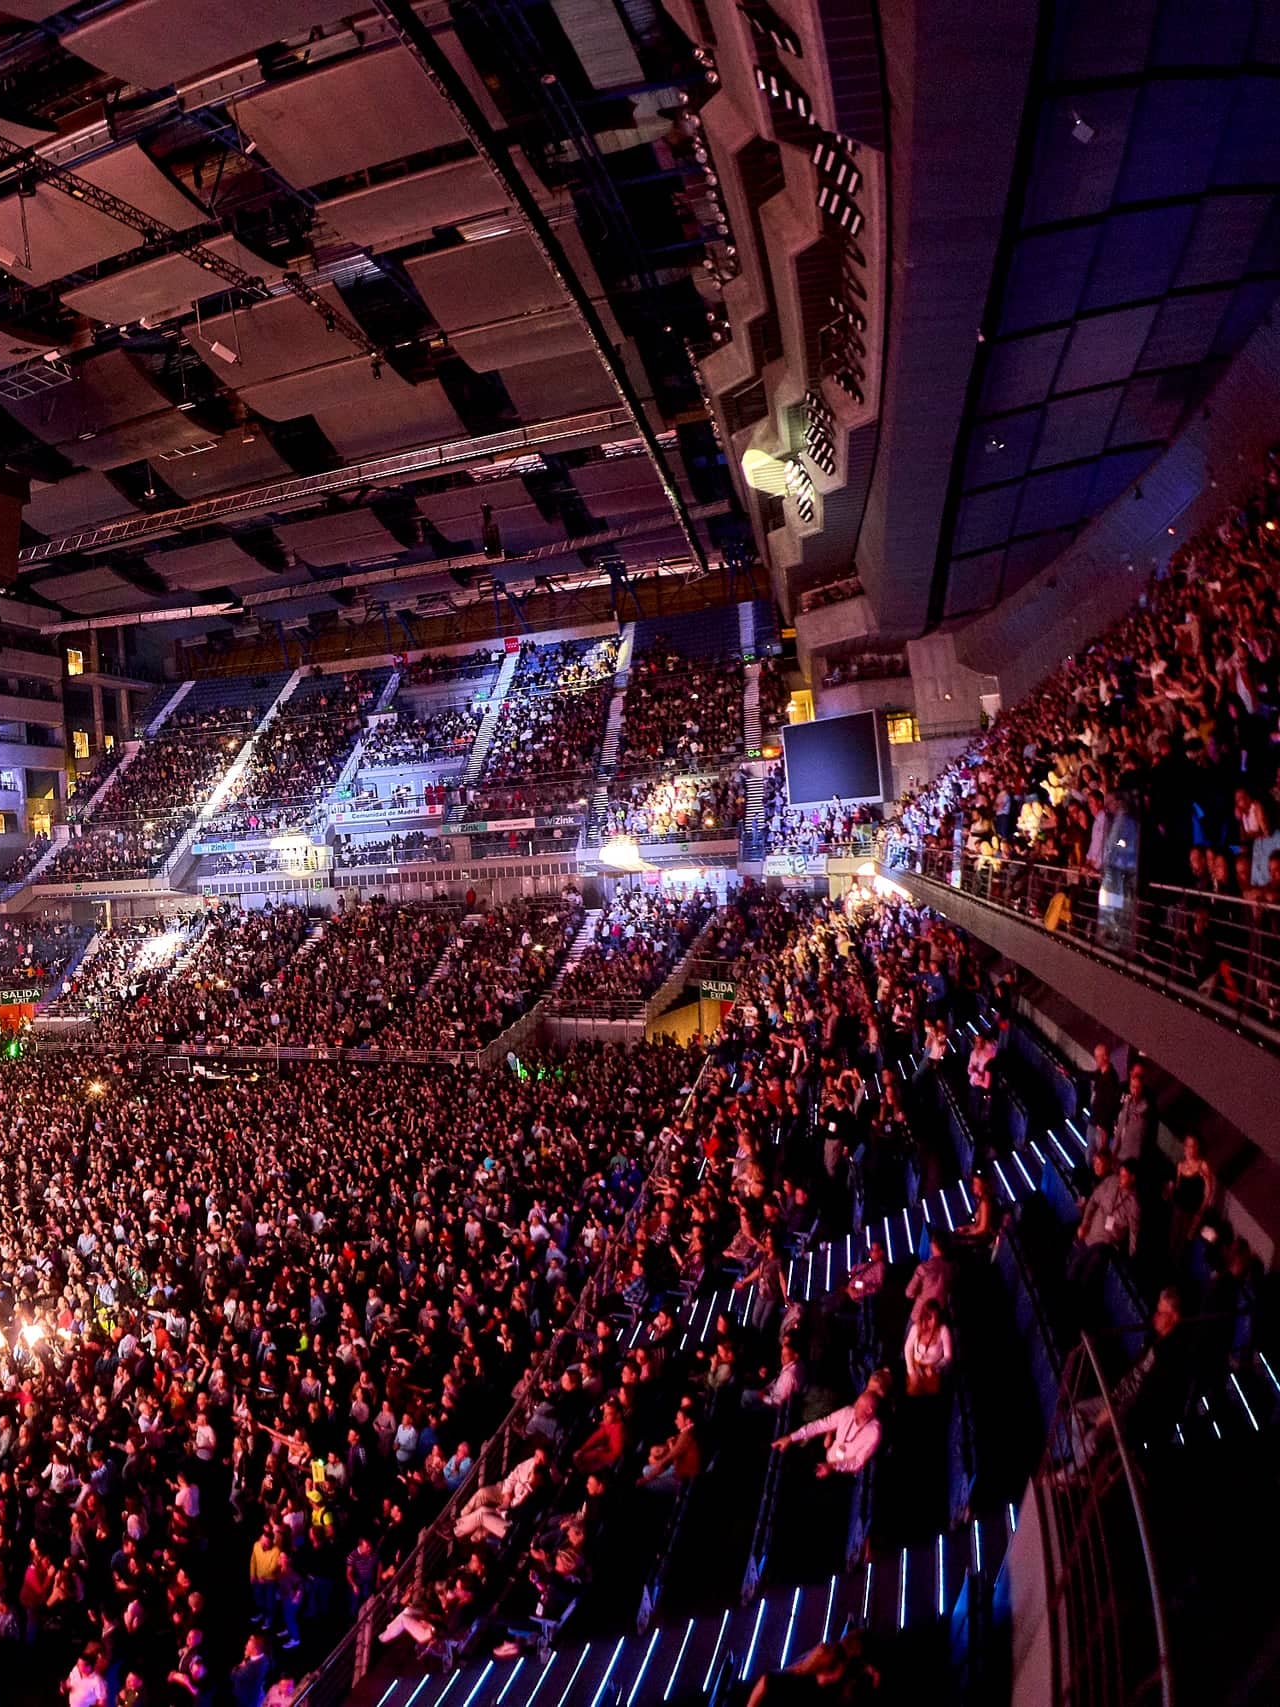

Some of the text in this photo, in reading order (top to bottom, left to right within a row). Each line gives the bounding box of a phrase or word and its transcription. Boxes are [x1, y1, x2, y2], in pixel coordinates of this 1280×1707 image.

[351, 809, 387, 819] Comunidad
[397, 807, 420, 815] Madrid
[702, 980, 733, 993] SALIDA
[2, 989, 40, 999] SALIDA
[710, 991, 725, 1000] EXIT
